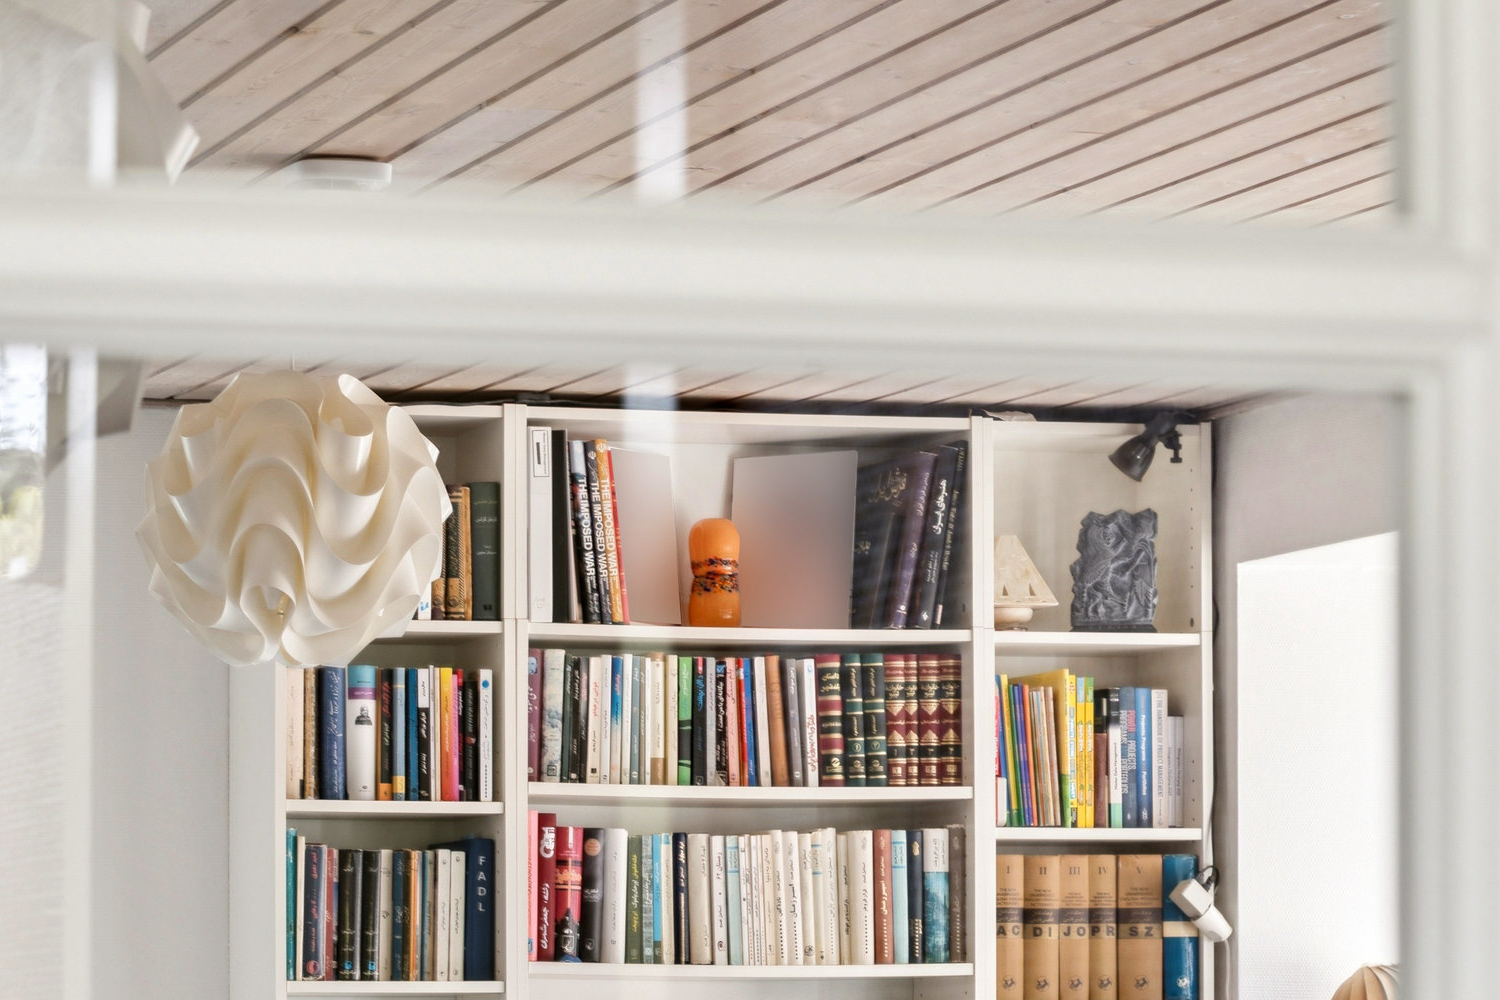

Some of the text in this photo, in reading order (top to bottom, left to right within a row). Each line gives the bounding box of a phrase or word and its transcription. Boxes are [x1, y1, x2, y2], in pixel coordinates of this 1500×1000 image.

[932, 480, 948, 535] هنرهای ایران
[579, 478, 596, 576] THE IMPOSED WAR
[590, 482, 608, 577] THE IMPOSED WAR
[600, 478, 618, 576] THE IMPOSED WAR
[696, 690, 705, 712] بهشت
[1128, 710, 1136, 732] POWER
[1039, 866, 1047, 875] II
[1069, 866, 1080, 875] III
[1098, 866, 1107, 874] IV
[996, 926, 1020, 936] A C
[1033, 926, 1043, 937] D
[1063, 926, 1086, 936] J O
[1091, 926, 1115, 936] P R
[1129, 926, 1153, 936] S Z
